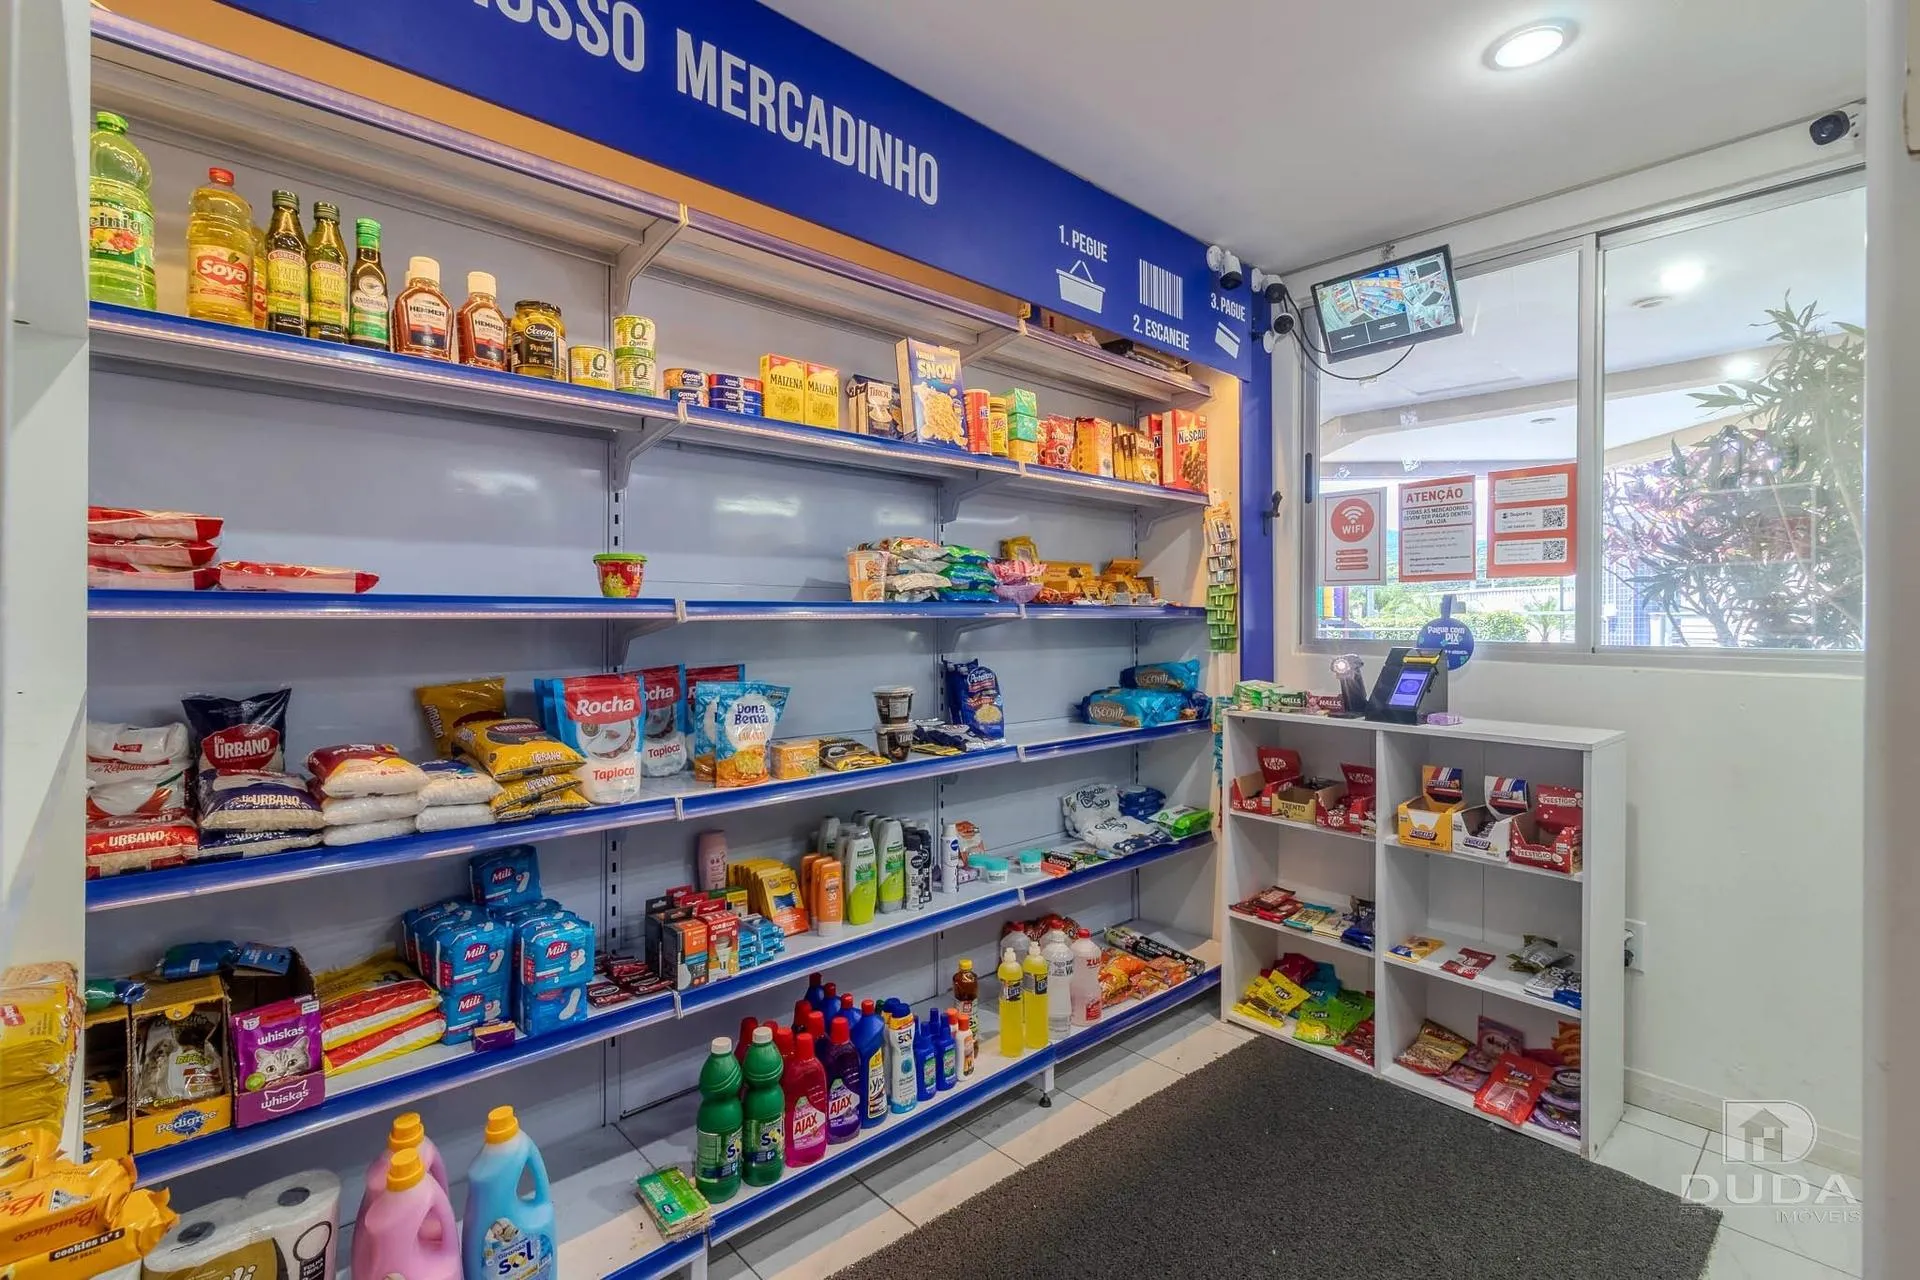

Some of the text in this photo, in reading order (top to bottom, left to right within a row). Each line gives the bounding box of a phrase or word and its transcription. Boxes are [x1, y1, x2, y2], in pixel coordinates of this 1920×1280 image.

[473, 0, 938, 205] SSO MERCADINHO
[1058, 224, 1108, 263] 1. PEGUE
[409, 304, 446, 317] HEMMER
[1210, 292, 1246, 322] 3. PAGUE
[474, 319, 504, 332] HEMMER
[1133, 314, 1190, 351] 2. ESCANEIE
[917, 361, 957, 380] SNOW
[769, 373, 803, 390] MAIZENA
[807, 380, 838, 396] MAIZENA
[1406, 487, 1463, 503] ATENÇÃO
[1342, 524, 1365, 535] WIFI
[1427, 626, 1449, 634] Pague
[643, 684, 674, 701] ocha
[576, 695, 635, 717] Rocha
[737, 703, 766, 715] Dona
[1319, 699, 1342, 707] HALLS
[214, 737, 270, 760] URBANO
[647, 743, 681, 758] Tapioca
[592, 766, 635, 782] Tapioca
[253, 794, 300, 806] URBANO
[1281, 802, 1306, 813] TRENTO
[108, 830, 165, 847] URBANO
[492, 868, 513, 883] Mili
[464, 944, 487, 961] Mili
[545, 942, 568, 958] Mili
[458, 994, 482, 1011] Mili
[257, 1026, 305, 1045] whiskas
[260, 1089, 310, 1110] whiskas
[830, 1094, 852, 1115] AJAX
[155, 1109, 217, 1136] Pedigree
[794, 1113, 818, 1135] AJAX
[54, 1239, 99, 1259] cookies
[498, 1240, 534, 1275] Sol
